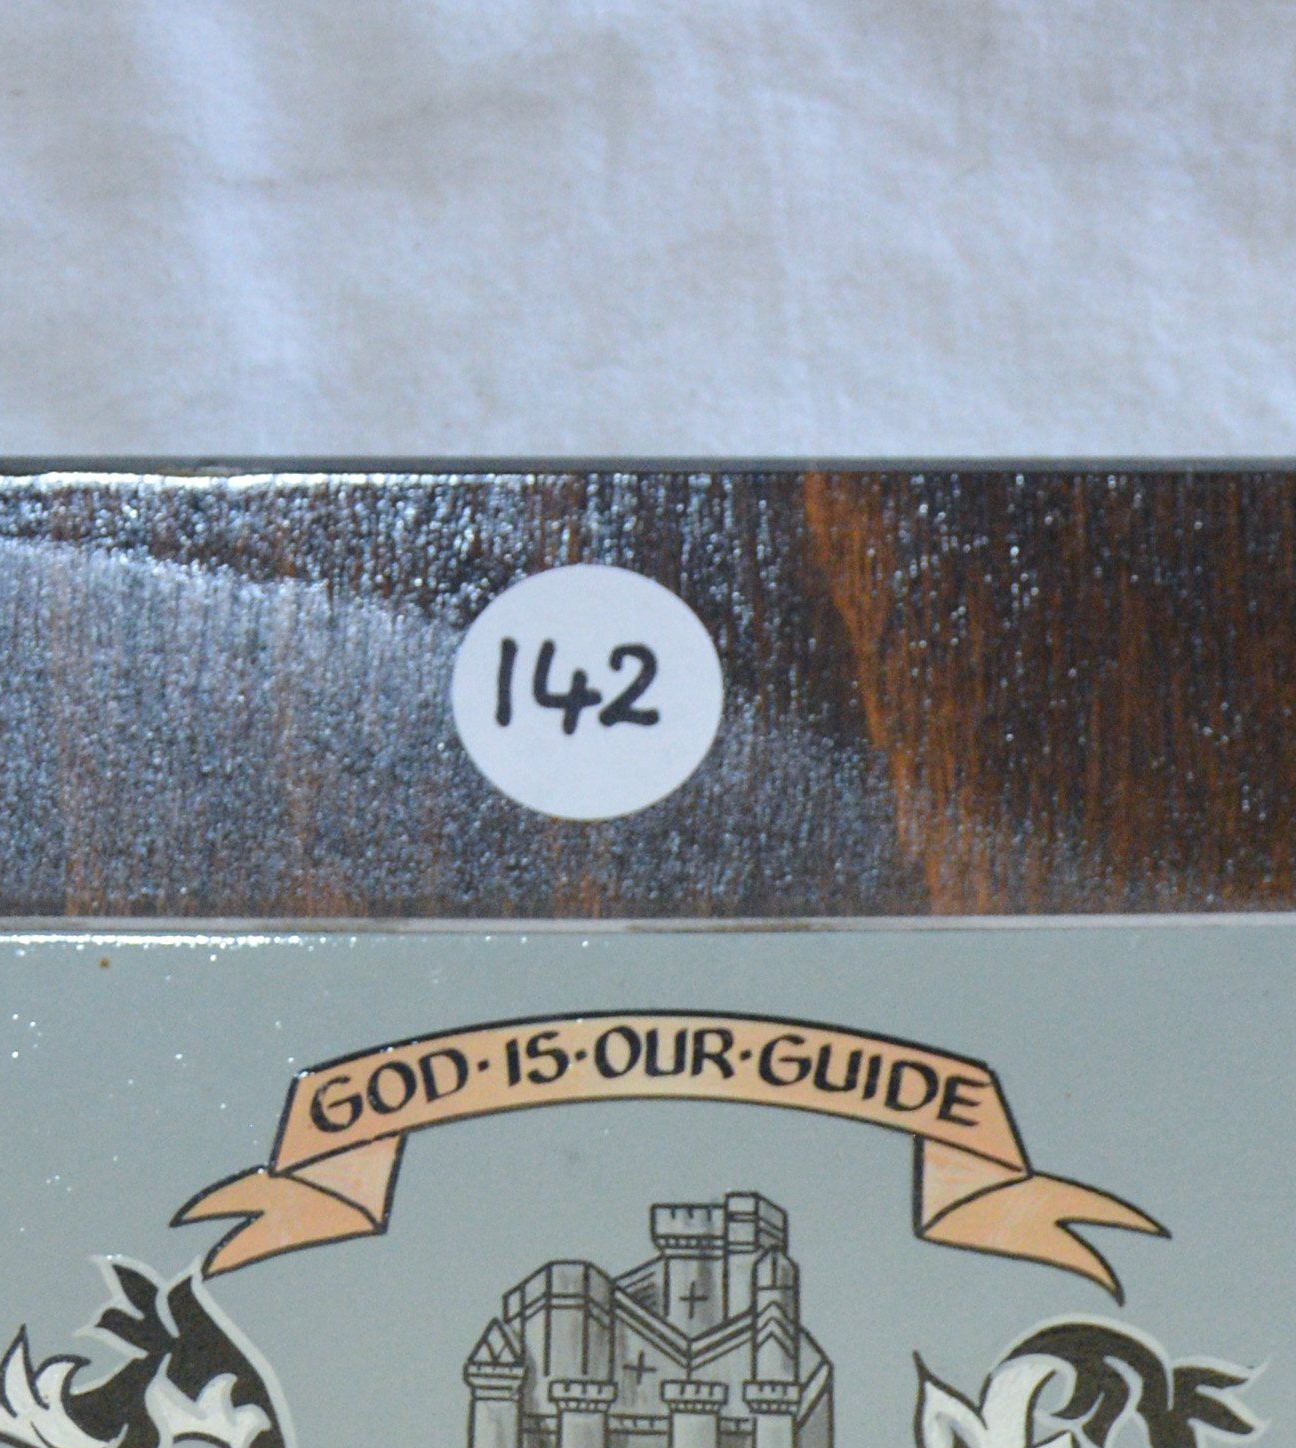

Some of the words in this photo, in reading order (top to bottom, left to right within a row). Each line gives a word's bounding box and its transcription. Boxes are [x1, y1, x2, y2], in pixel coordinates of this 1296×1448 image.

[495, 636, 660, 735] 142
[308, 1046, 470, 1133] GOD
[505, 1029, 574, 1087] IS
[595, 1024, 735, 1079] OUR
[757, 1034, 994, 1128] GUIDE
